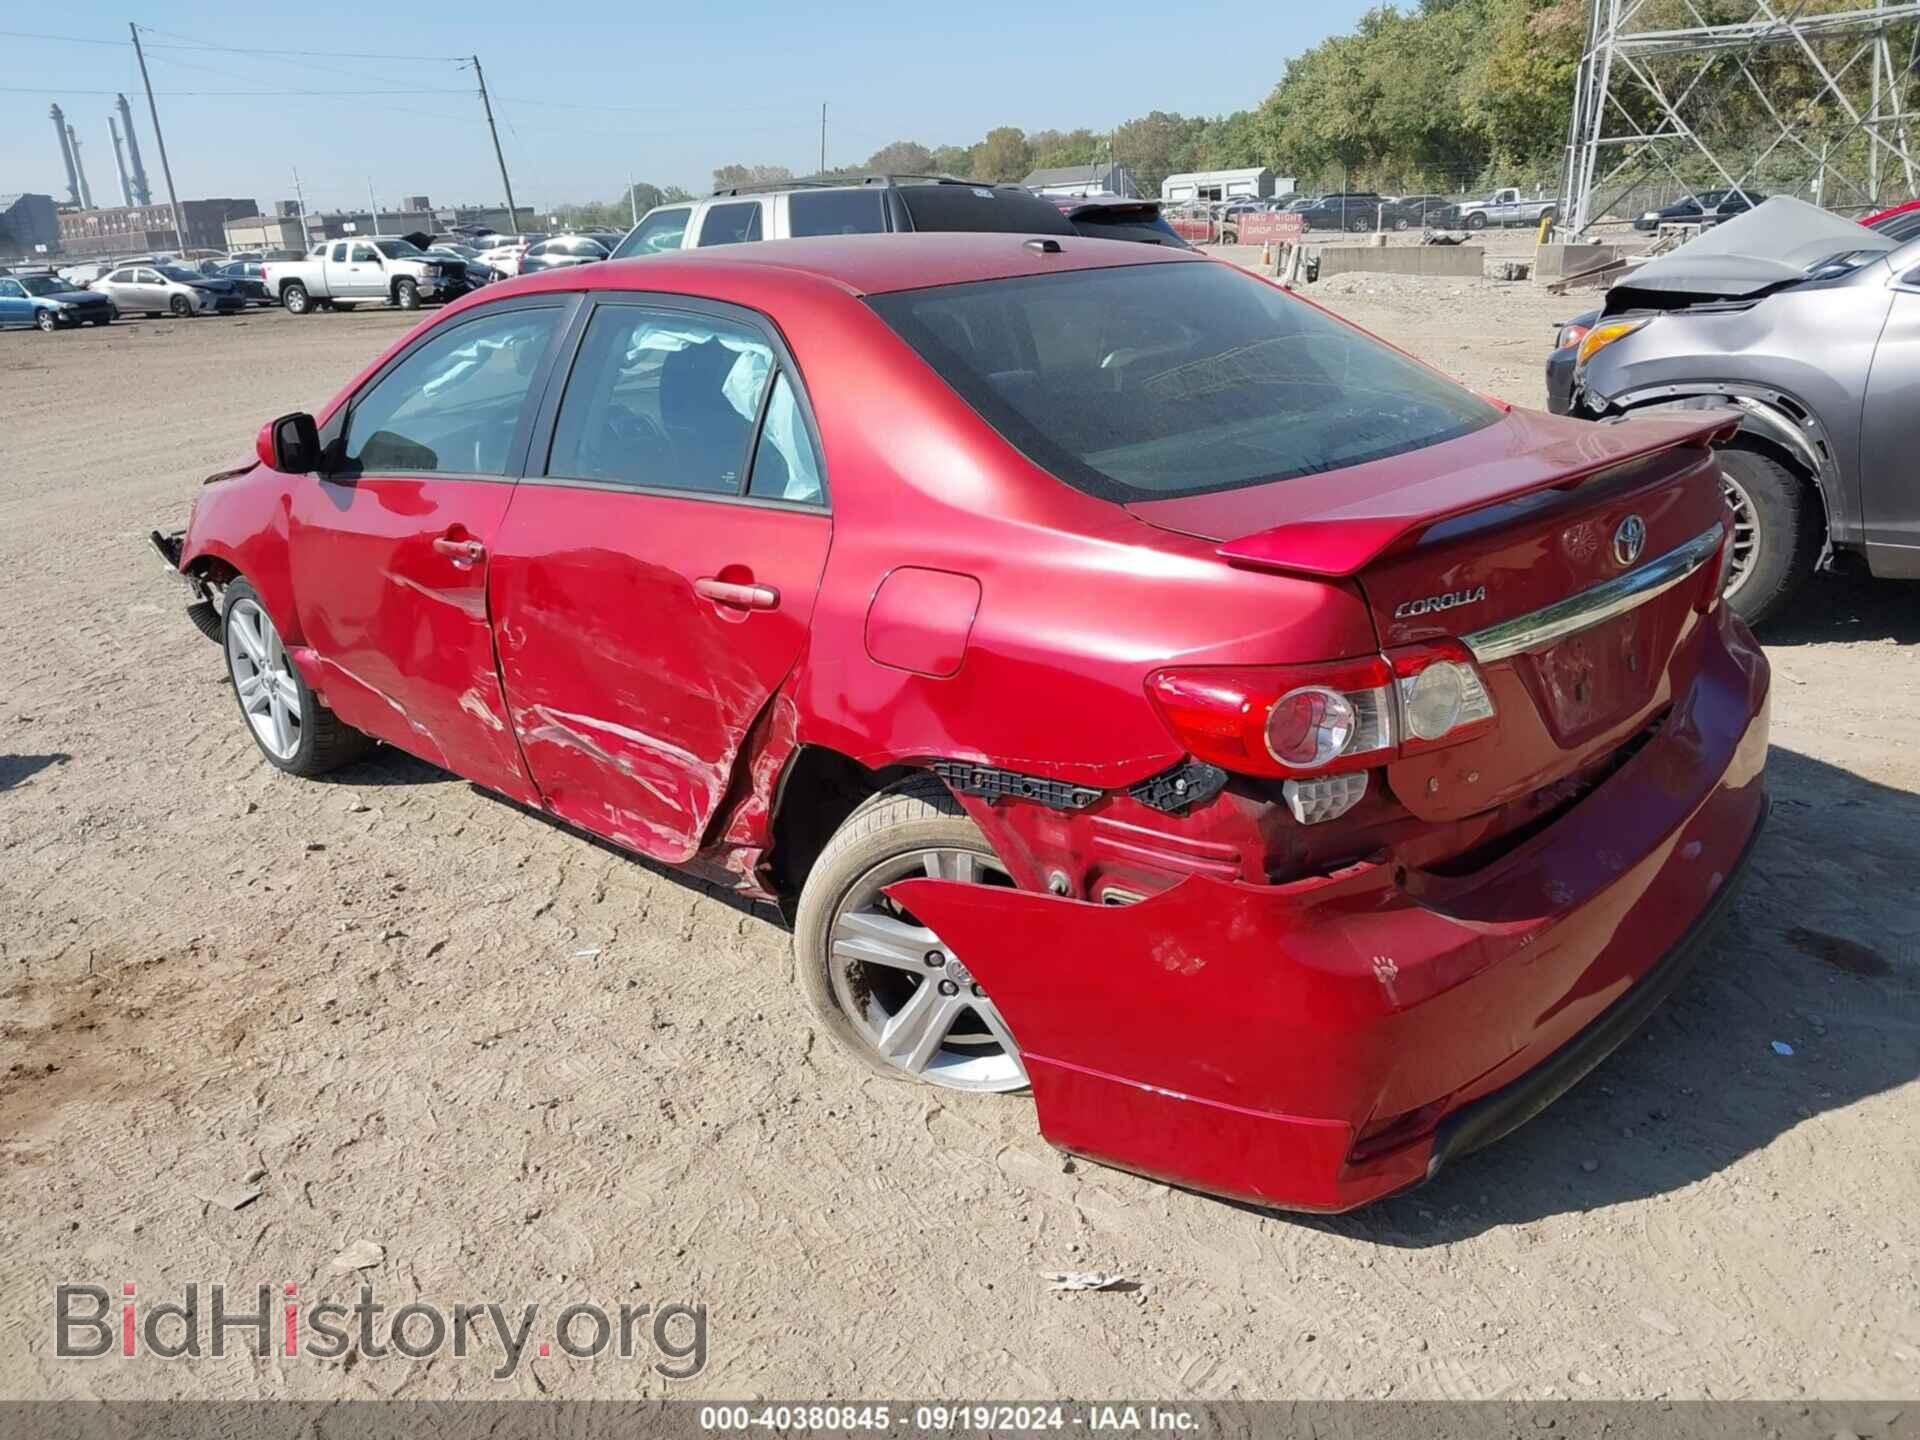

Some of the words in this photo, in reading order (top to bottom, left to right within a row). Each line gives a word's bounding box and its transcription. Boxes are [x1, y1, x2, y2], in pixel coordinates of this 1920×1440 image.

[1247, 225, 1273, 234] DROP
[1275, 223, 1301, 232] DROP
[1395, 586, 1486, 619] COROLLA
